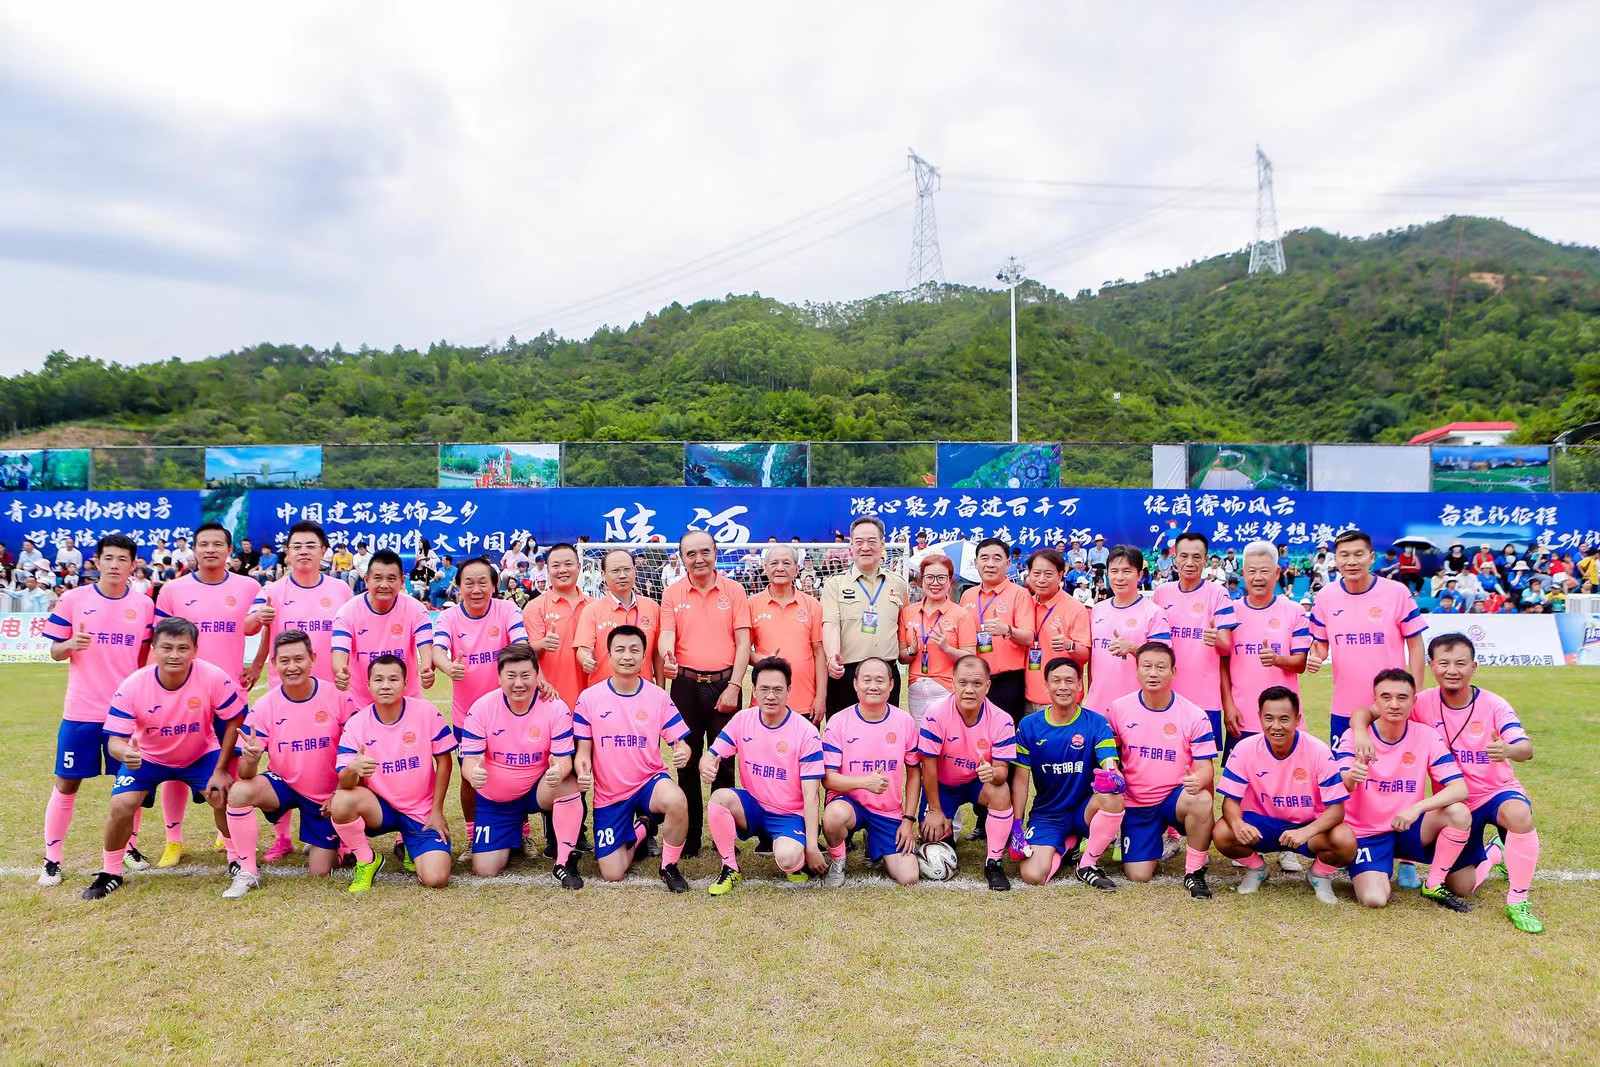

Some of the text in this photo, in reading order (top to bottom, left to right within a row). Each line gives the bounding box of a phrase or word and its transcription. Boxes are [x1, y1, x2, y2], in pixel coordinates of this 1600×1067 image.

[4, 497, 173, 523] 青山绿水好地方
[276, 500, 479, 526] 中国建筑装饰之乡
[850, 495, 1080, 518] 凝心聚力奋进百千万
[1144, 493, 1296, 517] 绿茵赛场风云
[1438, 504, 1558, 527] 奋进新征程
[194, 621, 236, 633] 东明星
[284, 620, 333, 631] 广东明星
[1335, 632, 1384, 645] 广东明星
[146, 722, 200, 737] 广东明星
[278, 737, 330, 752] 广东明星
[601, 734, 647, 748] 广东明星
[1331, 734, 1341, 751] 2
[64, 752, 75, 768] 5
[493, 751, 543, 765] 广东明星
[1128, 745, 1176, 762] 广东明星
[376, 756, 420, 774] 东明星
[1041, 761, 1083, 774] 广东明星
[1366, 779, 1417, 793] 广东明星
[1261, 793, 1314, 807] 广东明星
[475, 826, 490, 844] 71
[597, 827, 615, 848] 28
[1123, 836, 1131, 854] 9
[1355, 847, 1372, 864] 21
